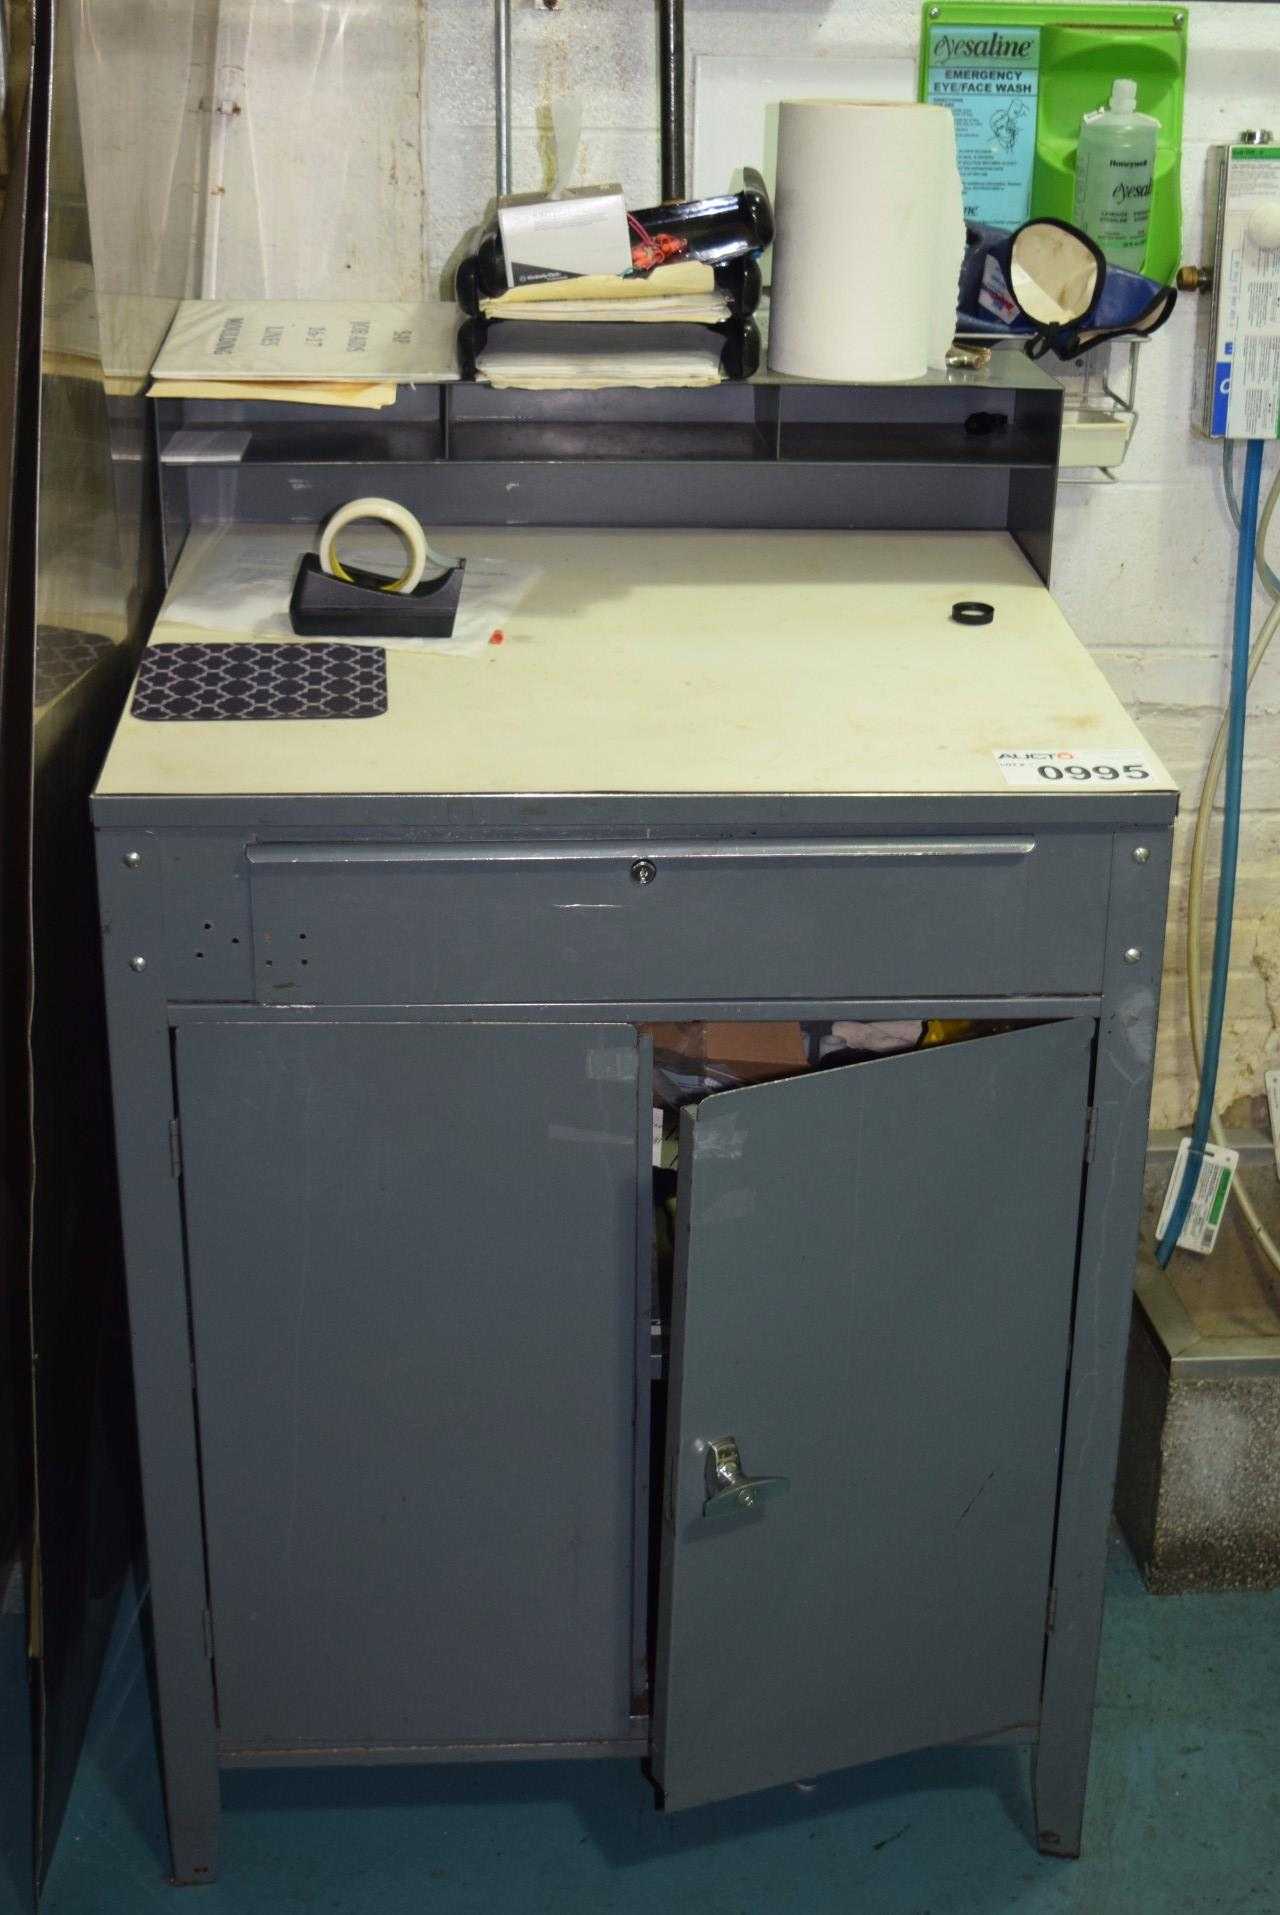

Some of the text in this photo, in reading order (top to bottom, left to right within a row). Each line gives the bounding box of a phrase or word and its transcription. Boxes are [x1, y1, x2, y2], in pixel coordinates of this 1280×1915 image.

[945, 70, 1023, 80] EMERGENCY
[933, 82, 1032, 93] EYE/FACE WASH
[1109, 159, 1148, 169] Honeywell
[1112, 177, 1152, 204] eyesal
[213, 318, 243, 355] MOULDING
[261, 326, 284, 346] LINES
[1037, 764, 1150, 781] 0995
